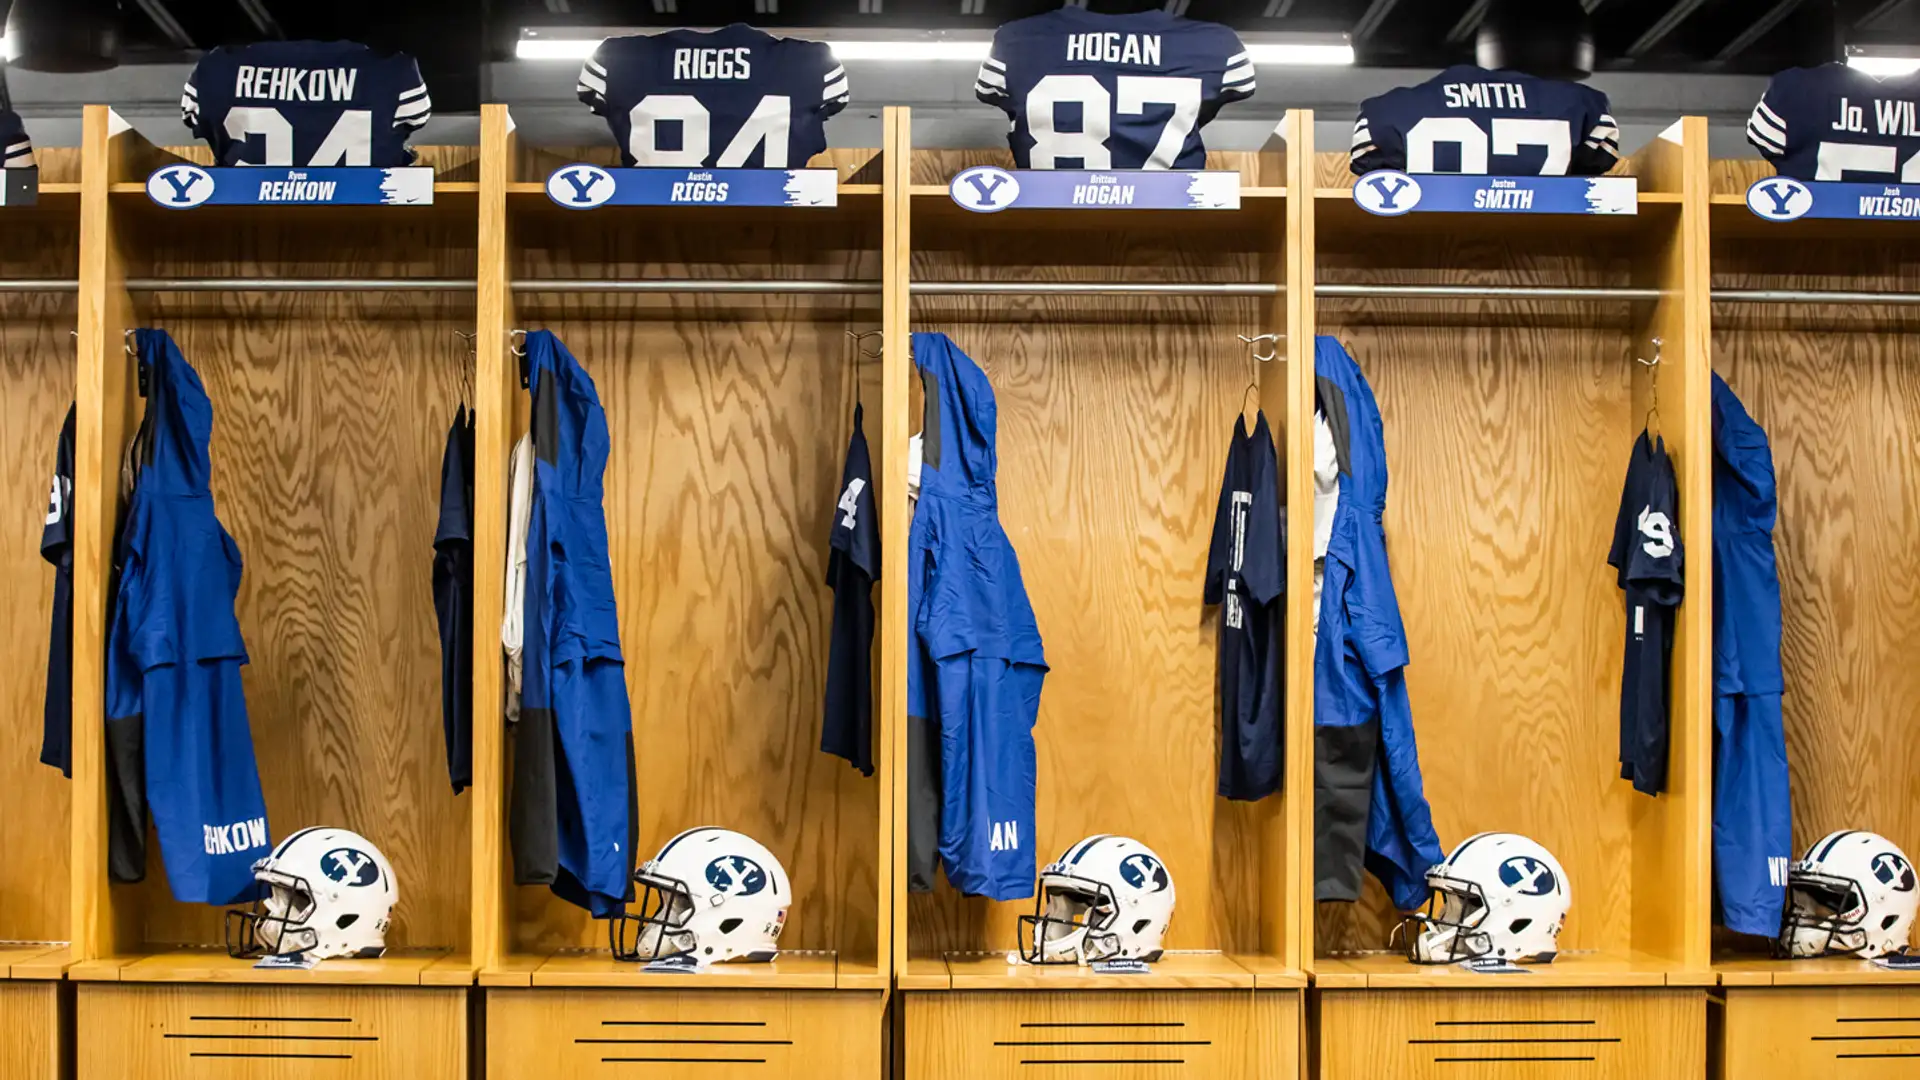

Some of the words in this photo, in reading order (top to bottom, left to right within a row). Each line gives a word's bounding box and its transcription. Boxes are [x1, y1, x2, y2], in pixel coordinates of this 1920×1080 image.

[673, 47, 750, 80] RIGGS
[1066, 32, 1161, 66] HOGAN
[235, 65, 357, 101] REHKOW
[1443, 83, 1526, 108] SMITH
[1026, 75, 1202, 170] 87
[1832, 97, 1868, 133] Jo.
[258, 181, 337, 201] REHKOW
[671, 182, 729, 202] RIGGS
[687, 171, 712, 181] Austin
[1072, 185, 1135, 204] HOGAN
[1474, 189, 1534, 209] SMITH
[838, 477, 866, 531] 4
[988, 818, 1018, 852] AN
